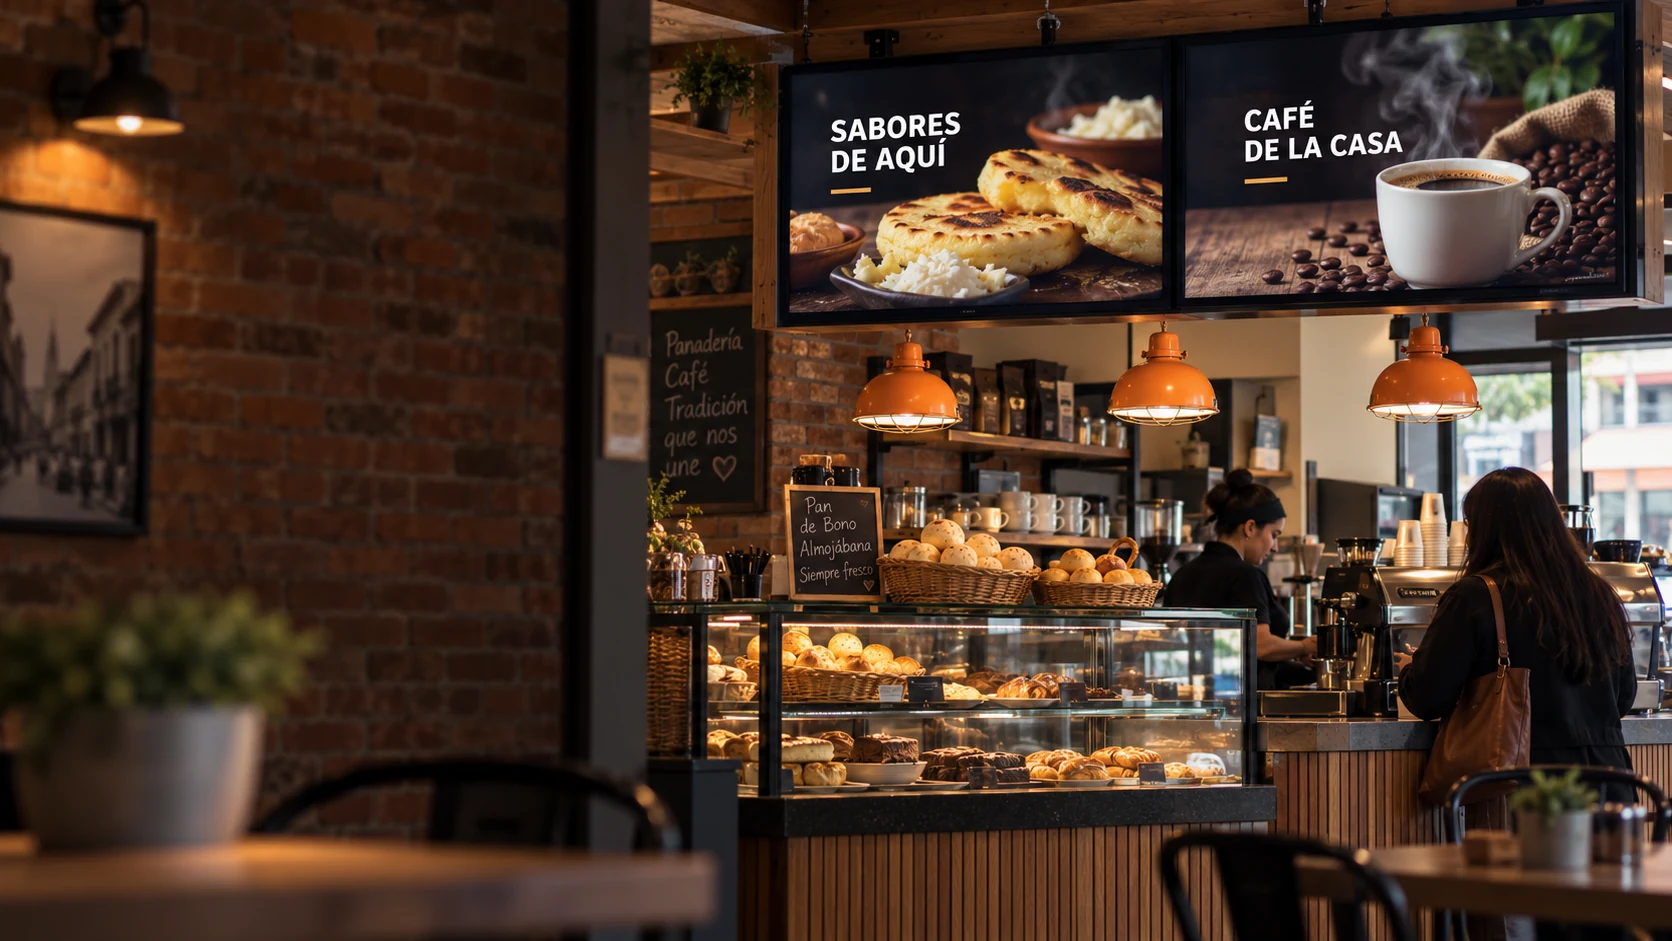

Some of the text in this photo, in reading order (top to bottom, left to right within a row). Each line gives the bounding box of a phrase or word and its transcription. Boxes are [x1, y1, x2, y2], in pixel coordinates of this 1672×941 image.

[830, 111, 961, 143] SABORES
[1244, 100, 1314, 132] CAFÉ
[831, 137, 946, 173] DE AQUÍ
[1245, 130, 1403, 162] DE LA CASA
[665, 327, 743, 357] Panadería
[665, 360, 709, 391] Café
[664, 392, 748, 421] Tradición
[664, 426, 738, 457] que nos
[665, 457, 702, 478] une
[804, 496, 833, 514] Pan
[800, 516, 857, 534] de Bono
[800, 537, 873, 561] Almojábana
[799, 561, 873, 586] Siempre fresco
